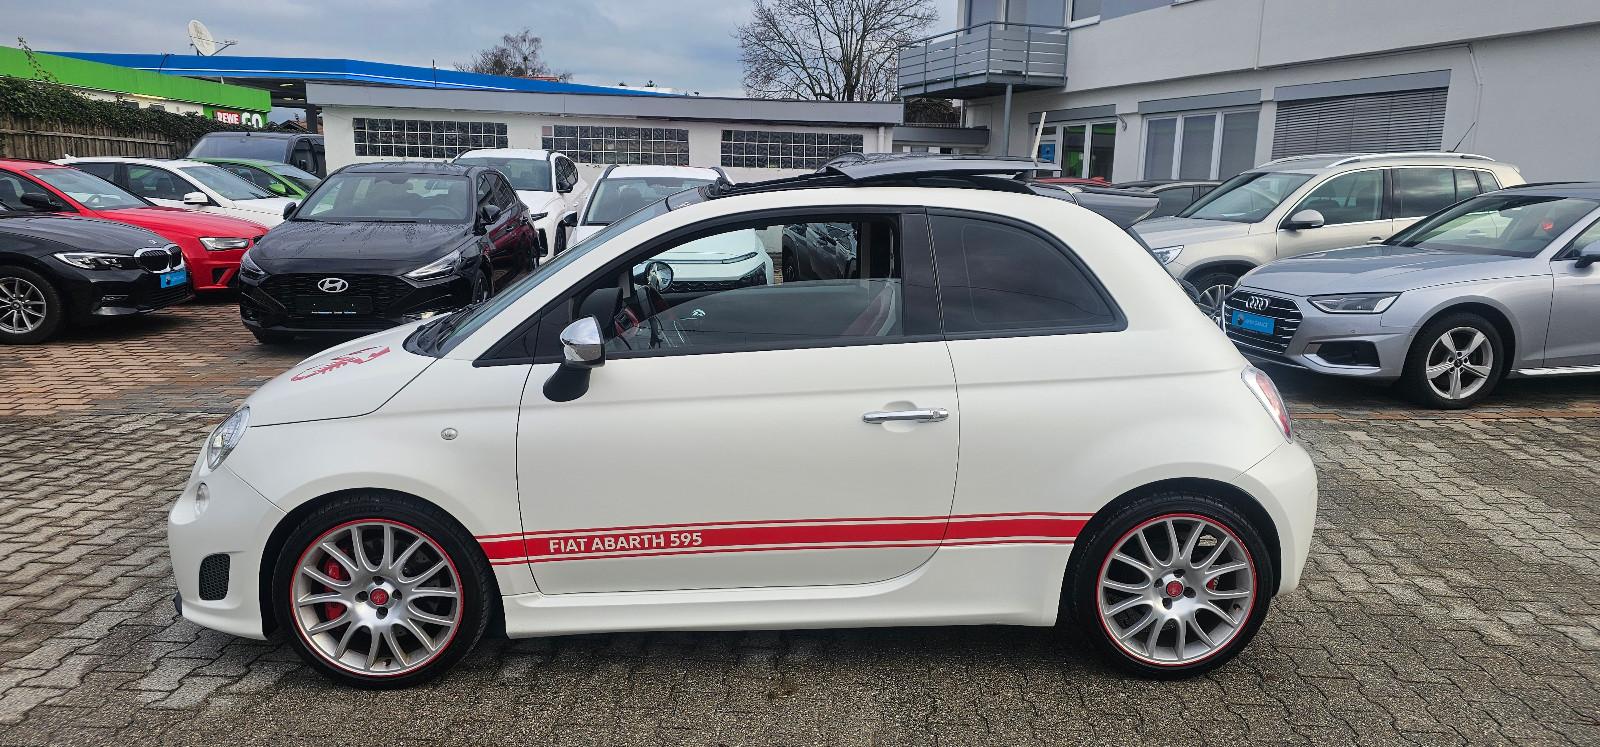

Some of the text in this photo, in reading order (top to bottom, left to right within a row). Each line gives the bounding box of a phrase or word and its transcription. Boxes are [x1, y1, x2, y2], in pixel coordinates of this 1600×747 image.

[217, 111, 239, 124] REWE
[549, 532, 703, 553] FIAT ABARTH 595
